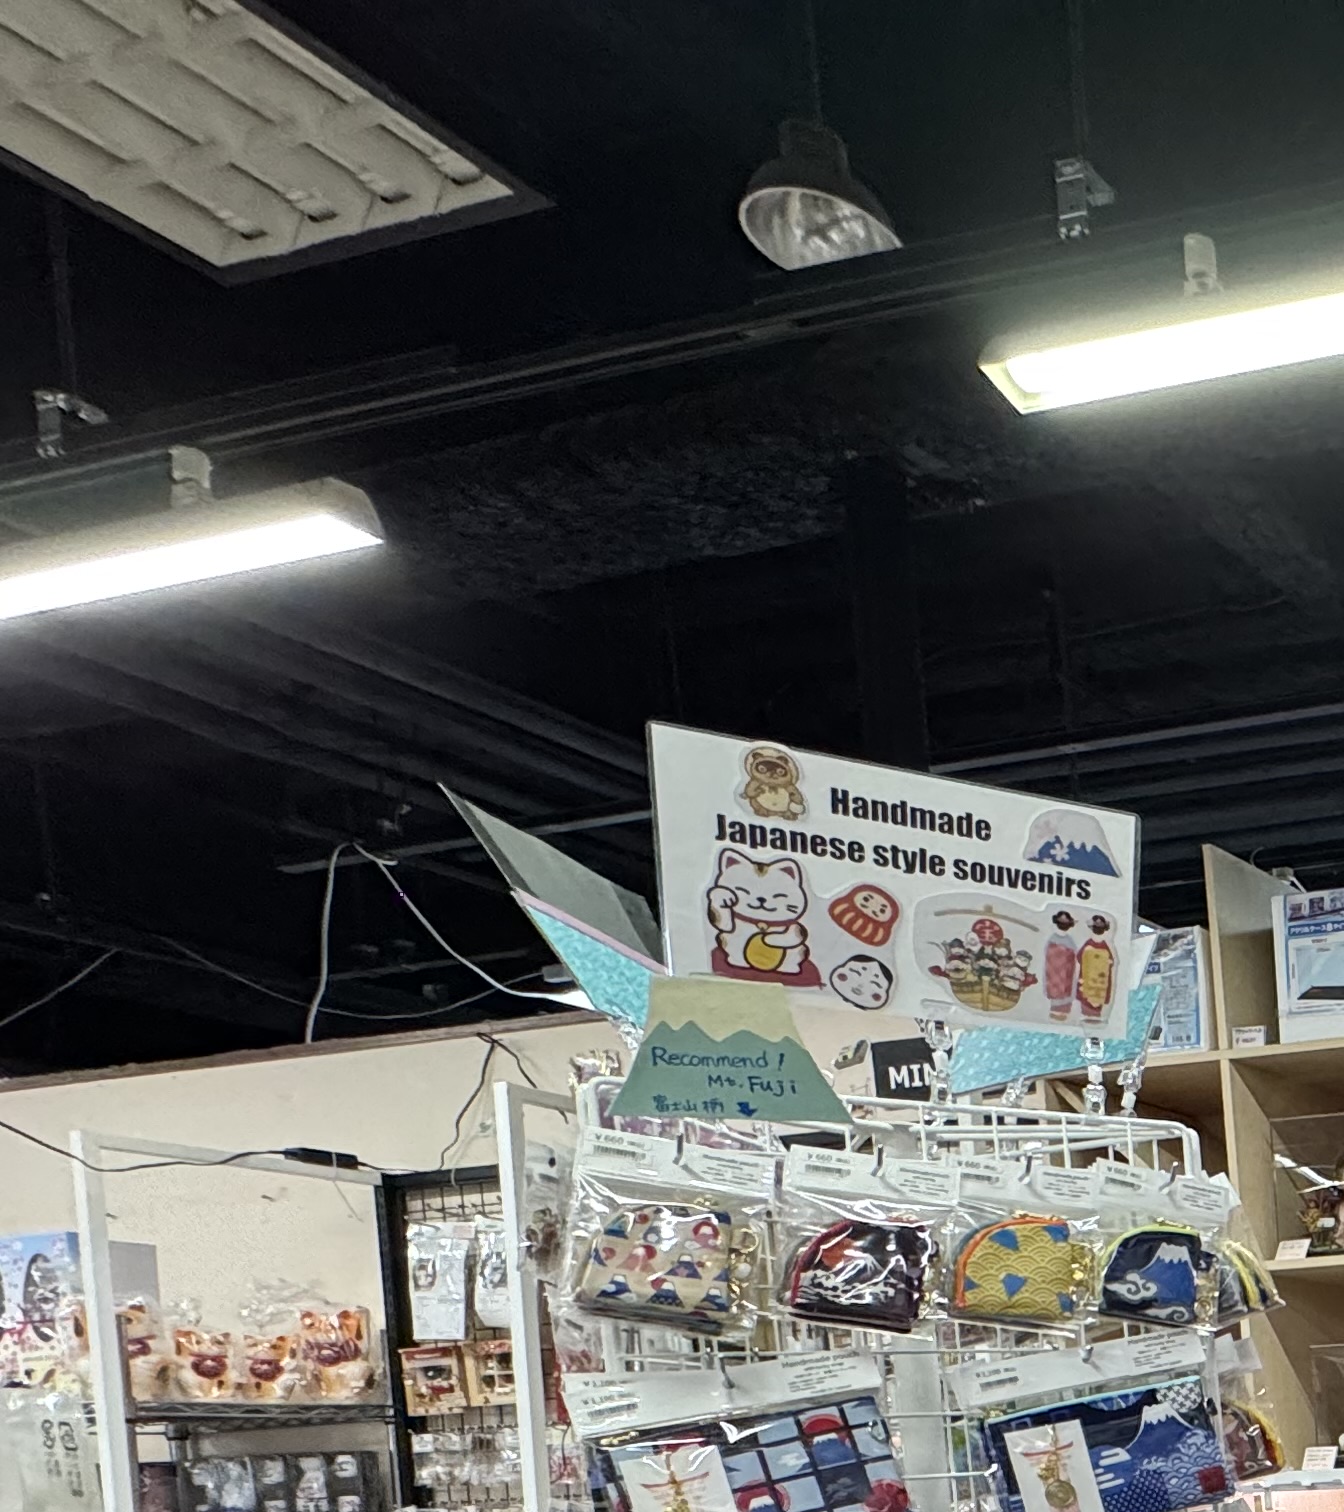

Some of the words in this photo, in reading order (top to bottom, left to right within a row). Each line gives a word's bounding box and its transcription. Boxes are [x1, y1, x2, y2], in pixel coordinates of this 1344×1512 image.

[830, 786, 992, 842] Handmade
[714, 813, 866, 865] Japanese
[872, 843, 946, 878] style
[952, 856, 1092, 902] souvenirs
[748, 1075, 798, 1096] Fuji
